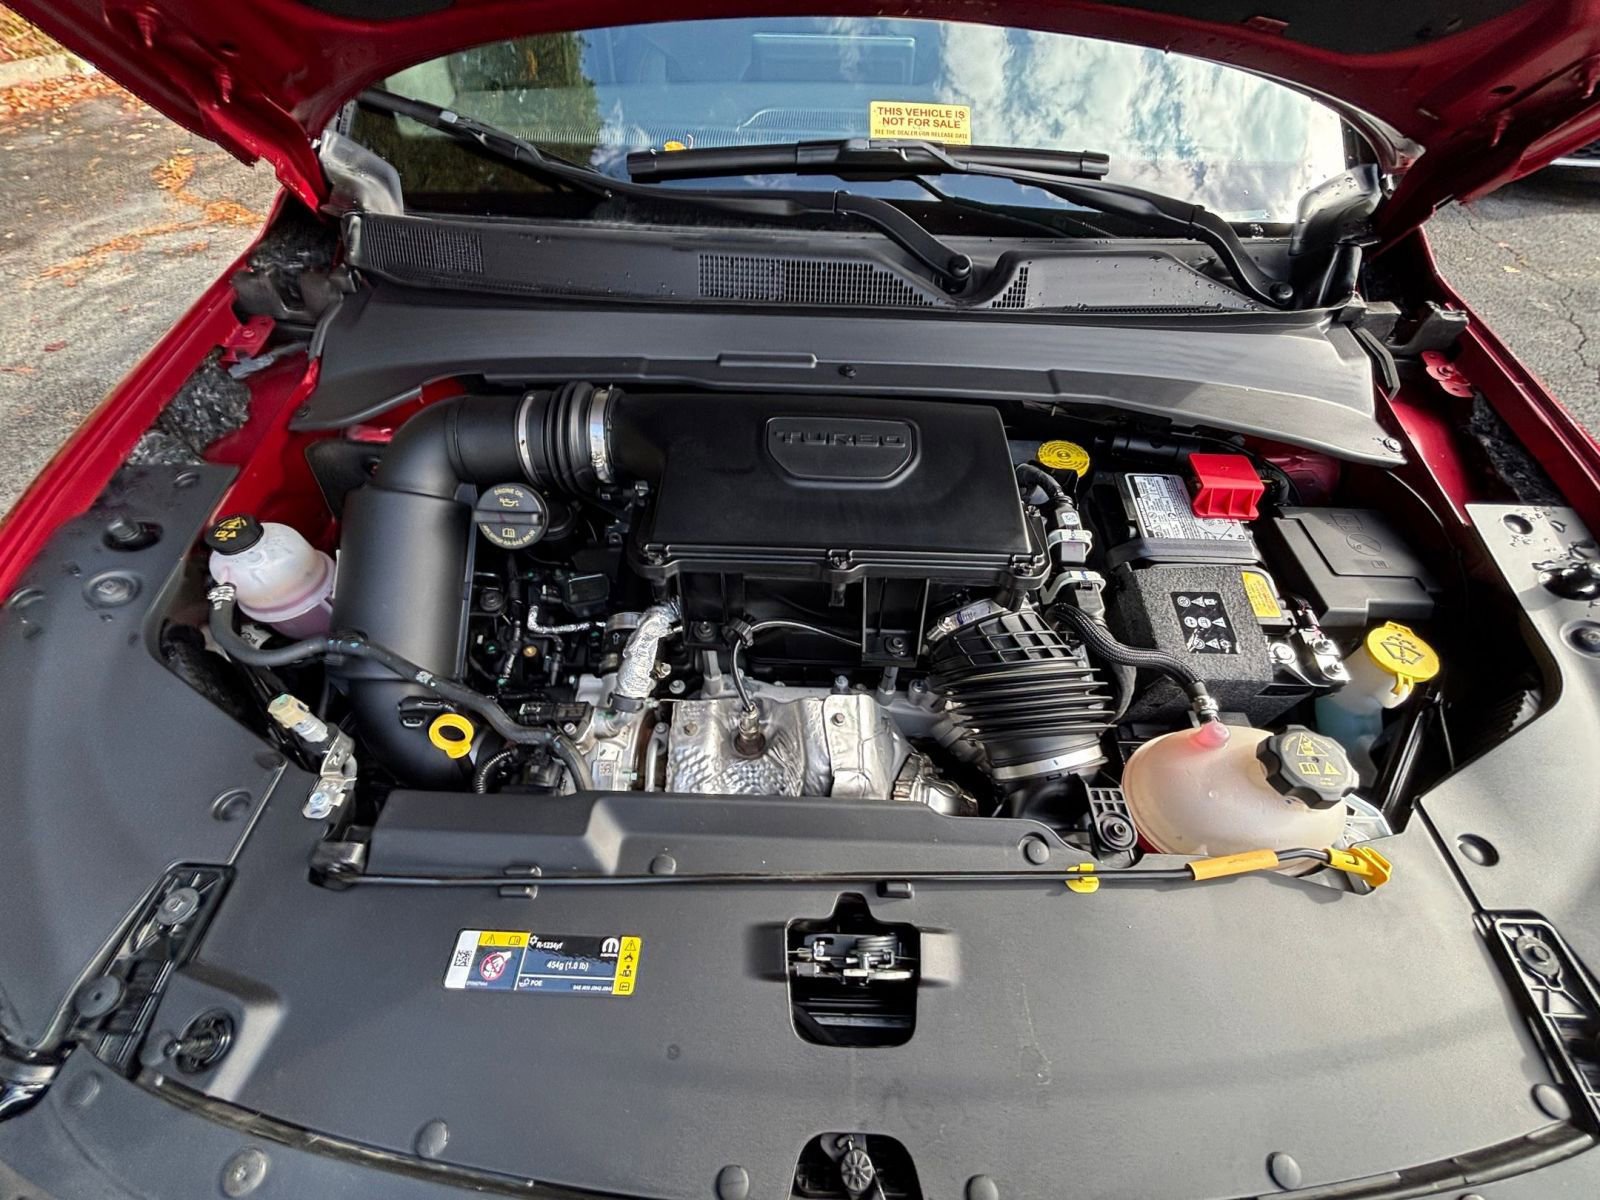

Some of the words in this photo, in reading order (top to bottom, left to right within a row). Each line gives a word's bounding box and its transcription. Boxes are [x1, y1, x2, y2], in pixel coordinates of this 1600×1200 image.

[877, 106, 903, 116] THIS
[905, 108, 953, 119] VEHICLE
[955, 110, 965, 120] IS
[882, 117, 905, 126] NOT
[907, 118, 930, 128] FOR
[933, 118, 961, 129] SALE
[774, 431, 906, 448] TURBO
[536, 941, 563, 951] R-1234yf
[546, 961, 564, 971] 454g
